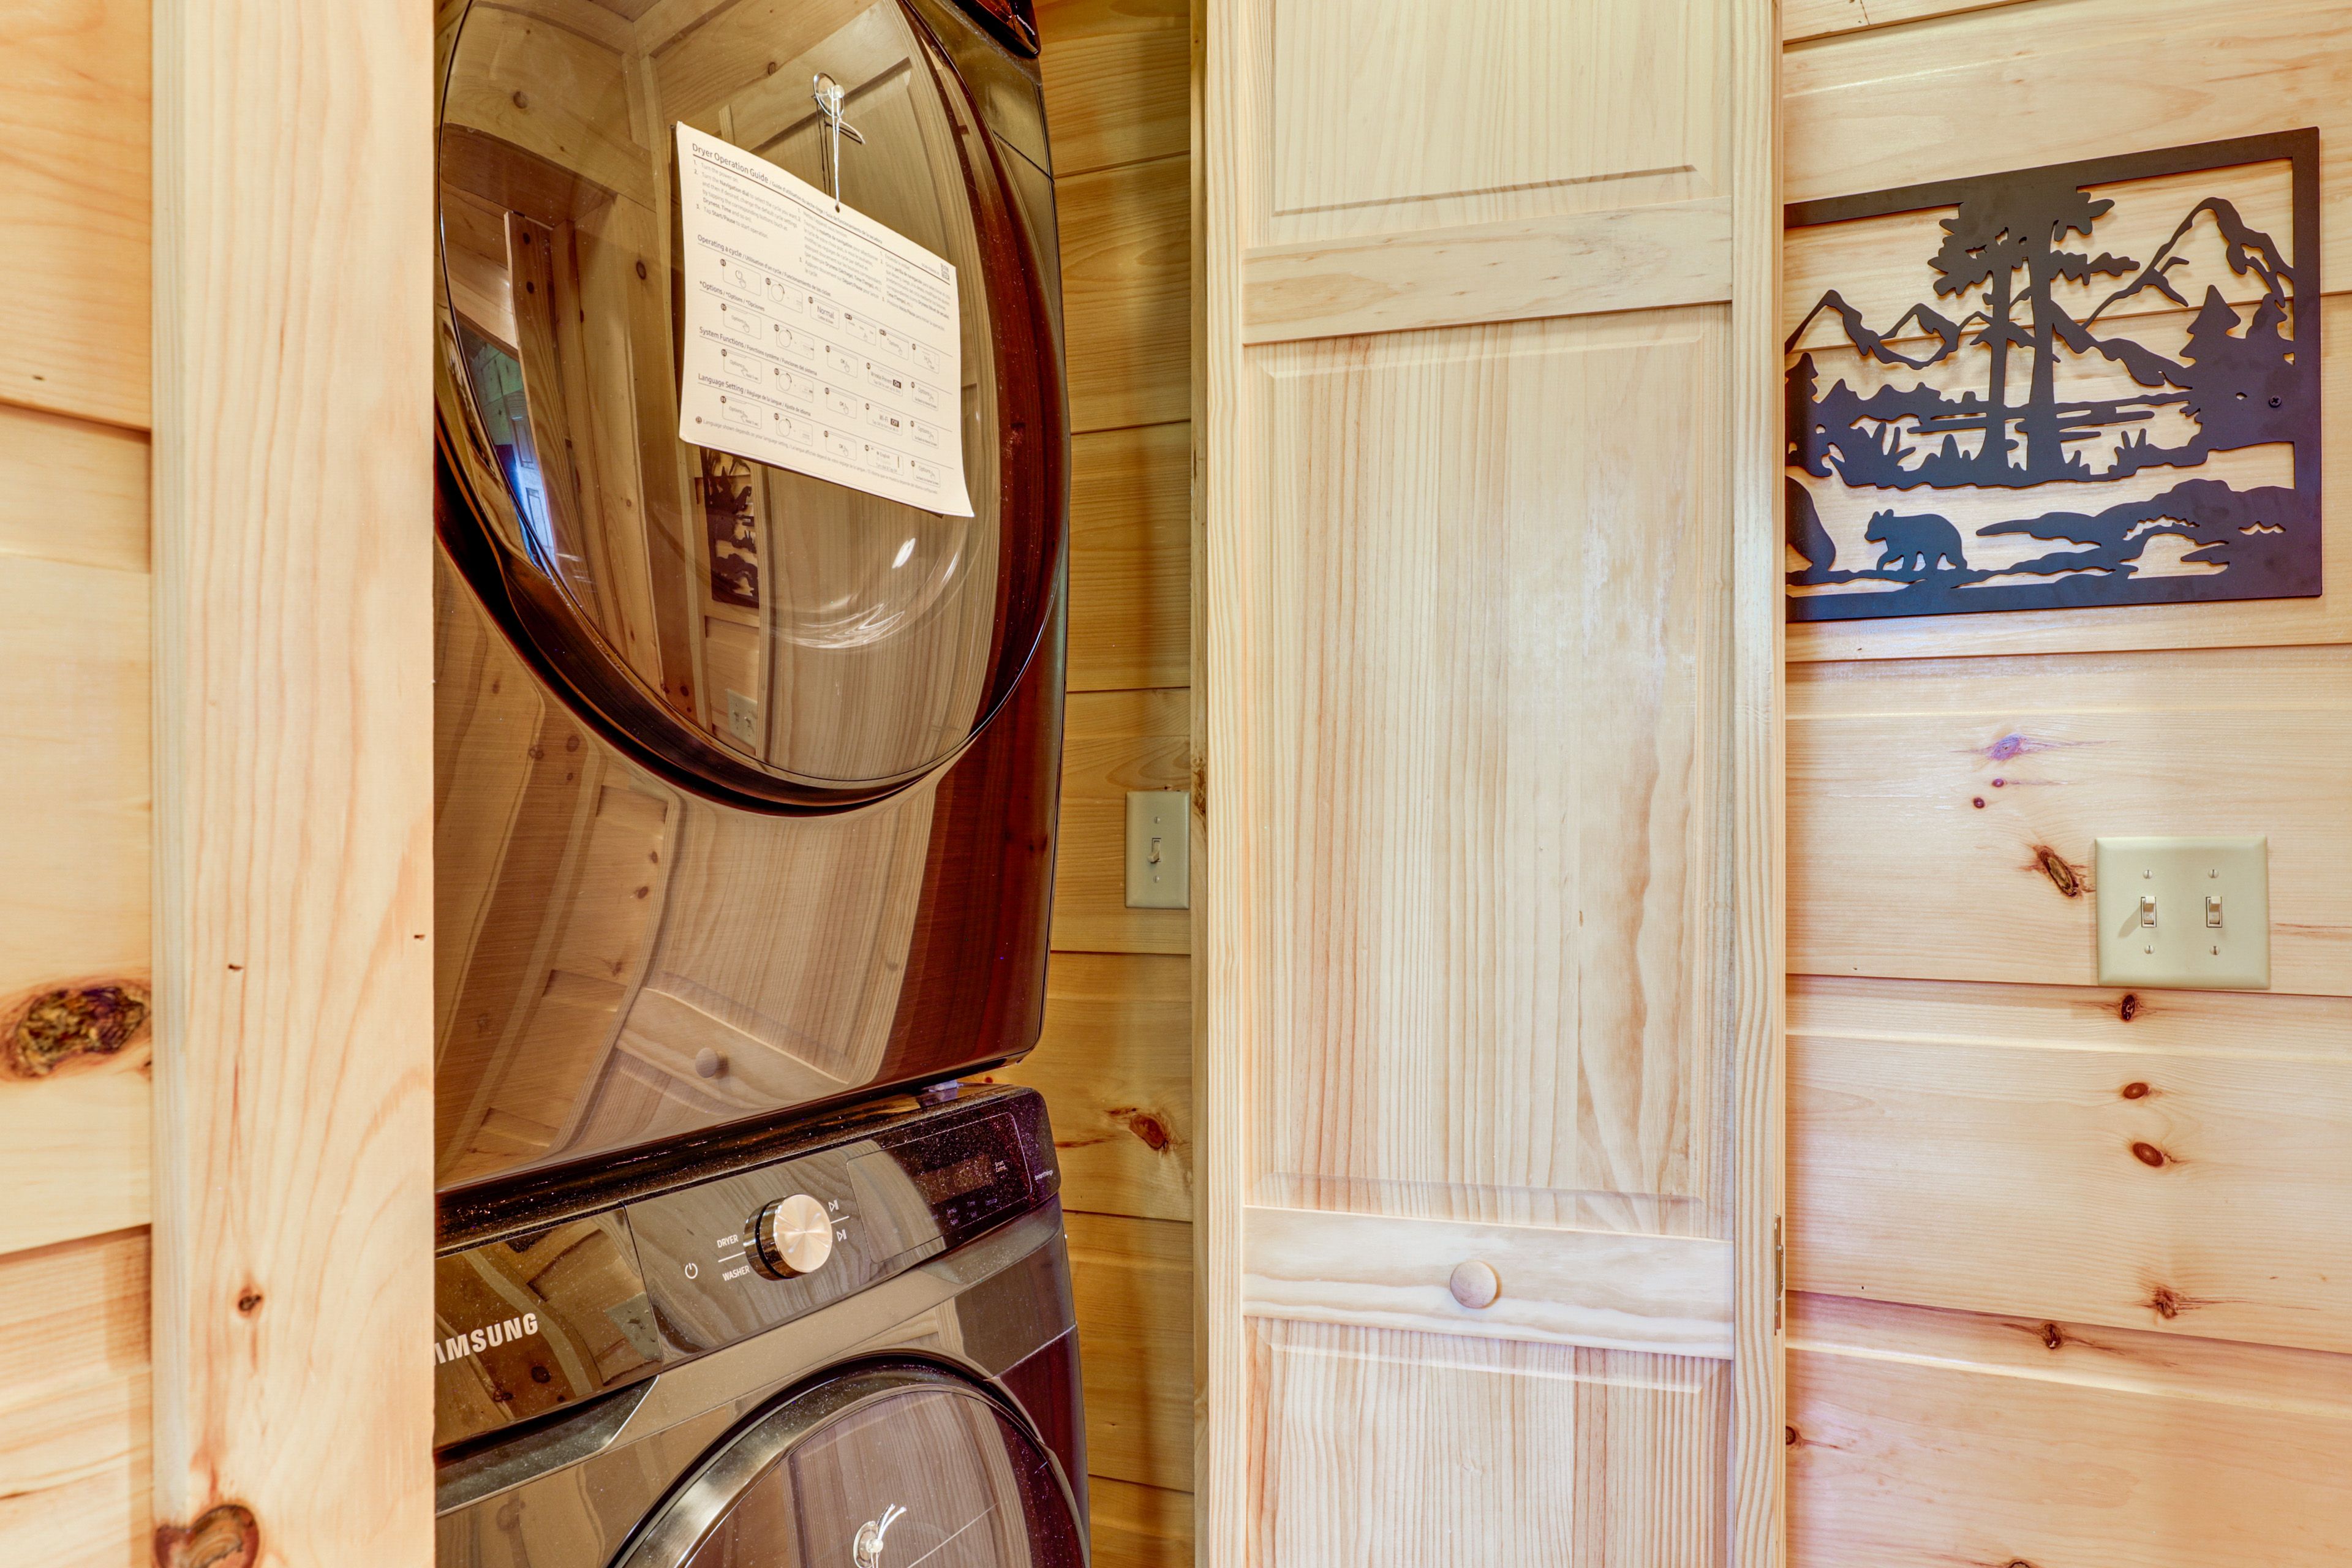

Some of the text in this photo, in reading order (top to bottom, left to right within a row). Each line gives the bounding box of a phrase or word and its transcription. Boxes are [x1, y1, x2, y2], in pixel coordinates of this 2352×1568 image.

[692, 143, 712, 157] Dryer
[715, 153, 748, 173] Operation
[750, 168, 768, 183] Guide
[720, 180, 741, 192] Navigation
[722, 205, 731, 213] Time
[712, 210, 735, 224] Start/Pause
[698, 235, 724, 251] Operating
[729, 248, 742, 257] cycle
[745, 255, 764, 266] Utilisation
[817, 306, 834, 318] Normal
[699, 326, 718, 338] System
[720, 334, 744, 347] Functions
[747, 345, 764, 355] Fonctions
[698, 374, 724, 387] Language
[725, 382, 744, 394] Setting
[894, 380, 901, 388] On
[703, 420, 722, 428] Language
[717, 1234, 739, 1248] DRYER
[722, 1265, 750, 1282] WASHER
[435, 1313, 538, 1365] AMSUNG
